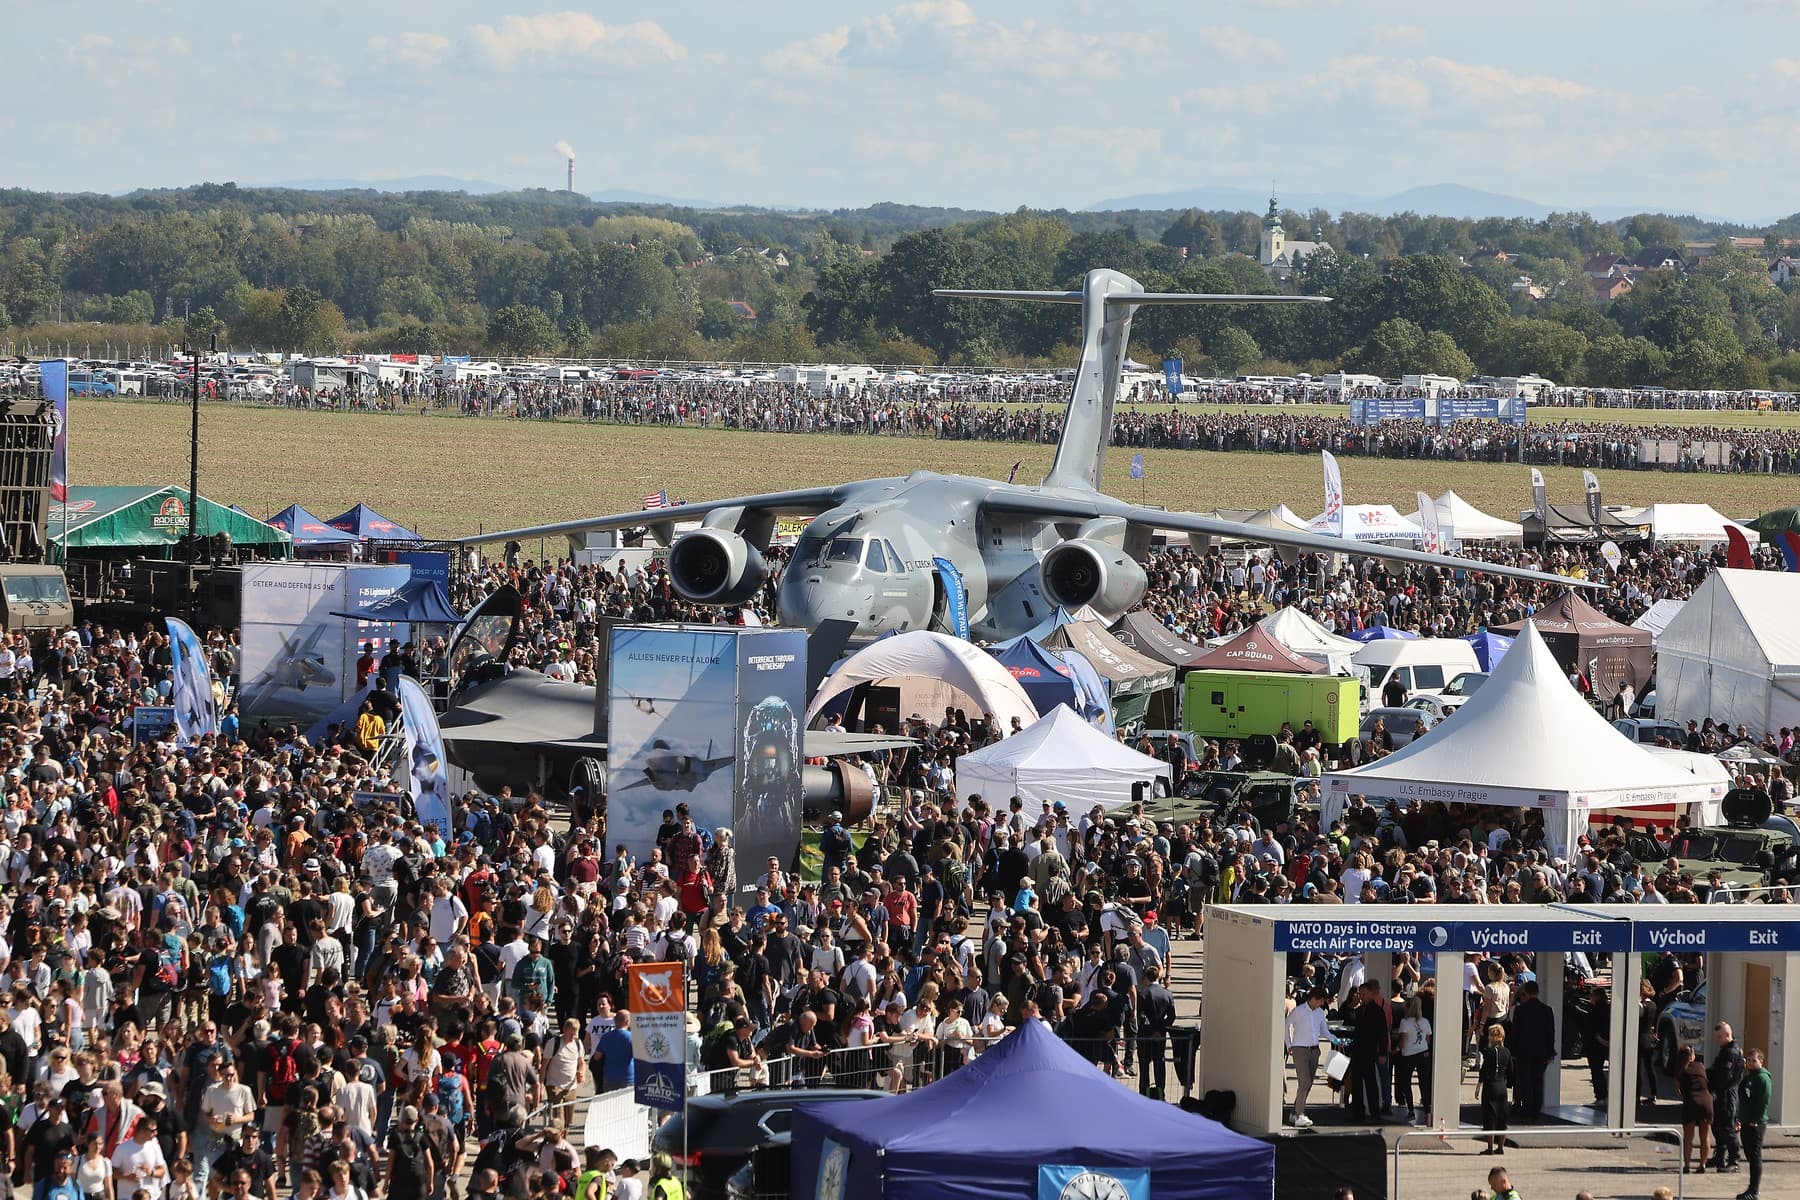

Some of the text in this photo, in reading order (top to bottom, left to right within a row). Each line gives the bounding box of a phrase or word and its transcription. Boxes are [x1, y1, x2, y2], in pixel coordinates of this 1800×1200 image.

[252, 580, 273, 588] DETER
[274, 581, 288, 589] AND
[288, 582, 312, 590] DEFEND
[628, 653, 720, 665] ALLIES NEVER FLY ALONE
[1226, 650, 1243, 658] CAP
[1245, 651, 1273, 661] SQUAD
[1399, 785, 1488, 801] U.S. Embassy Prague
[1289, 922, 1417, 938] NATO Days in Ostrava
[1573, 930, 1602, 945] Exit
[1749, 930, 1778, 945] Exit
[1291, 938, 1414, 952] Czech Air Force Days
[1471, 928, 1528, 948] Východ
[1649, 928, 1706, 948] Východ
[647, 1087, 672, 1097] NATO
